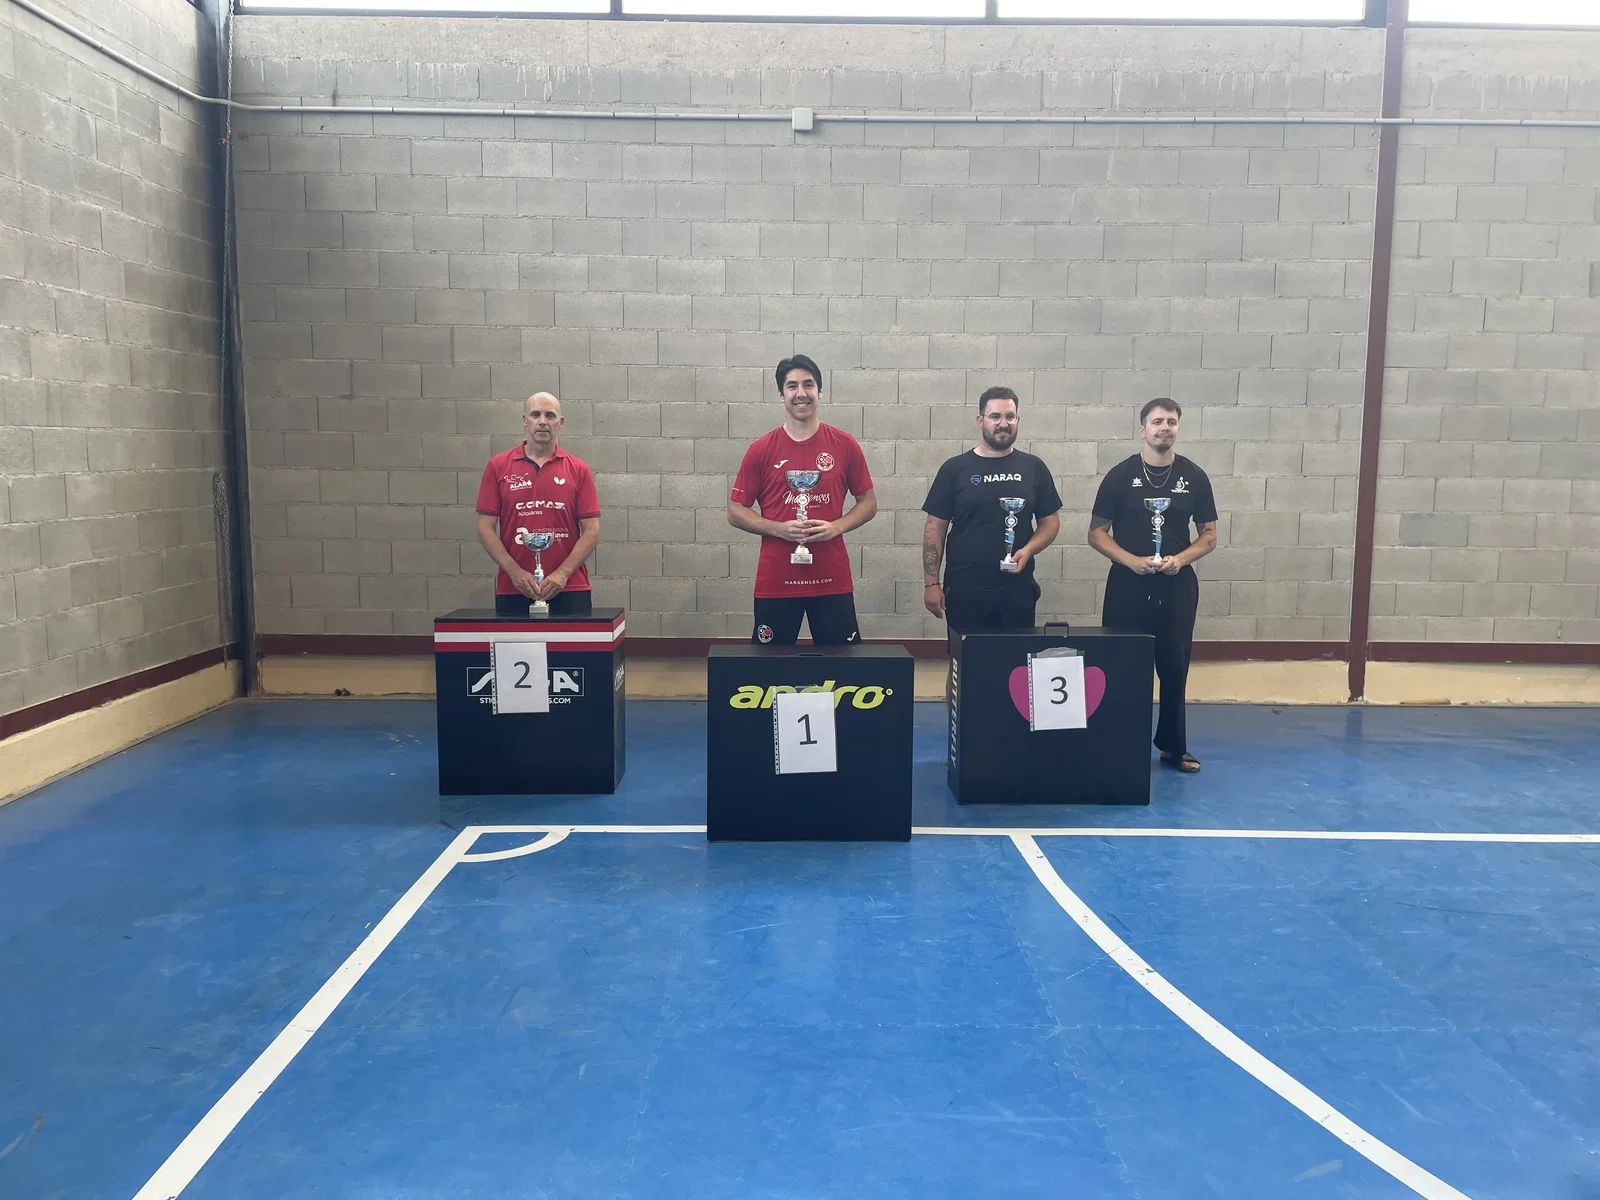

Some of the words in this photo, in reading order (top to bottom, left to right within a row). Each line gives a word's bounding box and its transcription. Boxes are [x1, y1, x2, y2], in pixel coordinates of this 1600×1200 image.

[983, 473, 1022, 483] NARAQ
[513, 661, 532, 689] 2
[1050, 676, 1069, 704] 3
[797, 713, 818, 746] 1
